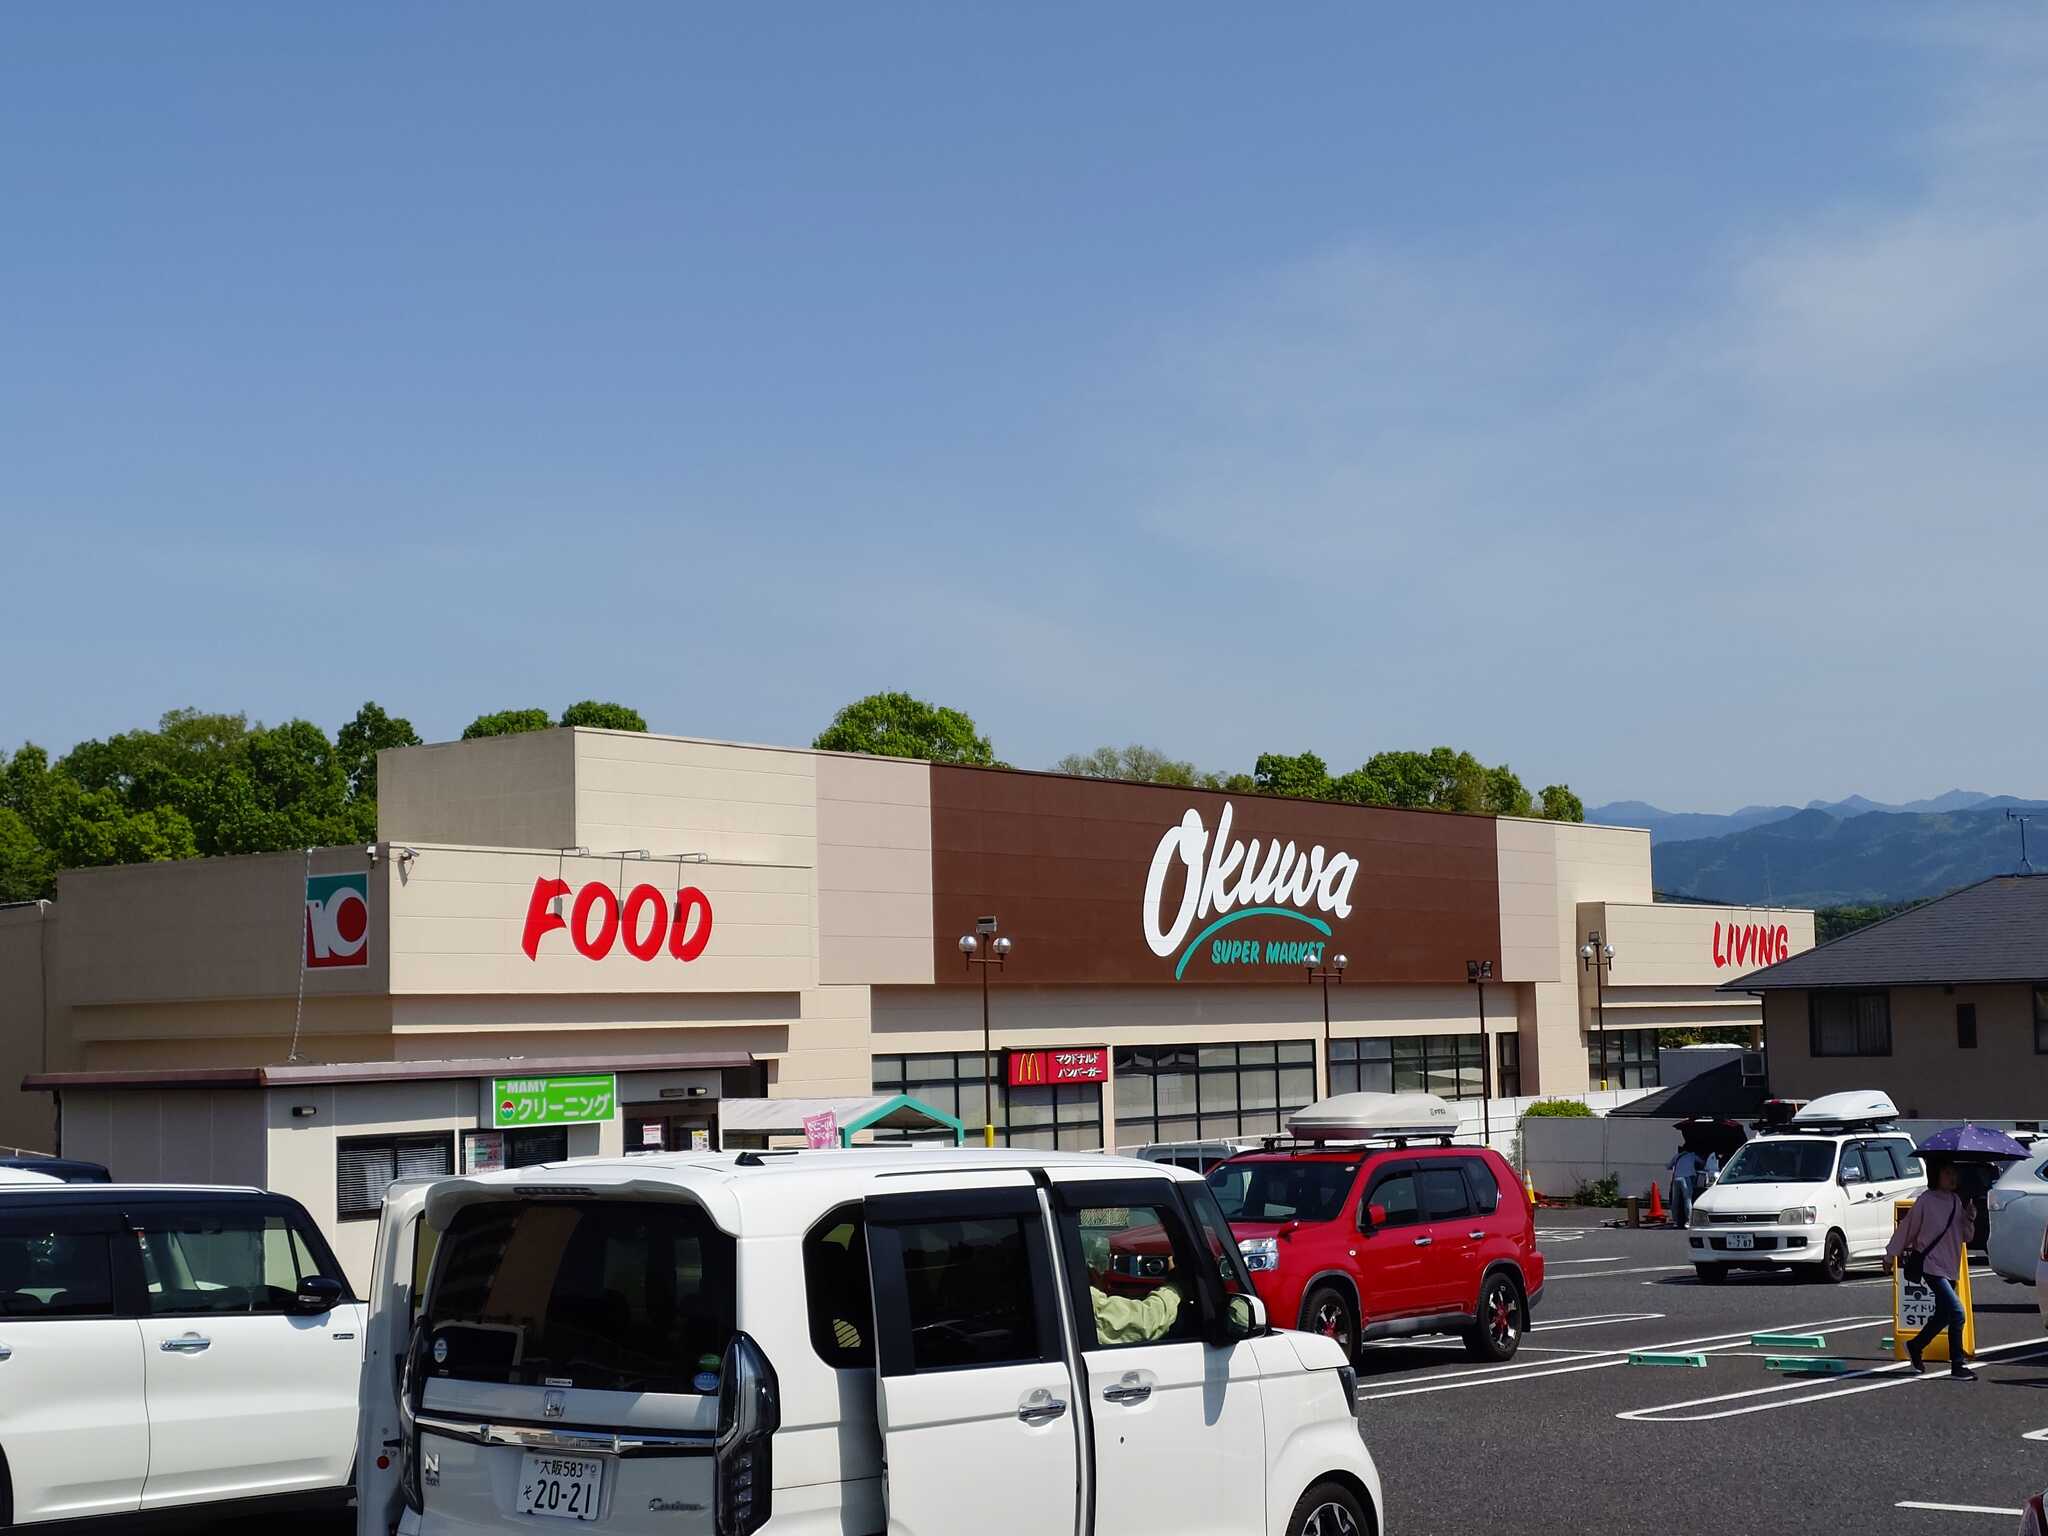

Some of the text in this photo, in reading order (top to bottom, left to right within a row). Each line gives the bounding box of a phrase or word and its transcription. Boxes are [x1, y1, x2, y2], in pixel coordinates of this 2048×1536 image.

[1143, 801, 1359, 957] Okuwa
[521, 876, 713, 962] FOOD
[1211, 939, 1326, 964] SUPER MARKET
[1713, 920, 1788, 968] LIVING
[1056, 1052, 1099, 1065] マクドナルド
[1058, 1066, 1102, 1078] ハンバーガー
[507, 1080, 547, 1094] MAMY
[518, 1093, 611, 1120] クリーニング
[534, 1479, 592, 1514] 20-21
